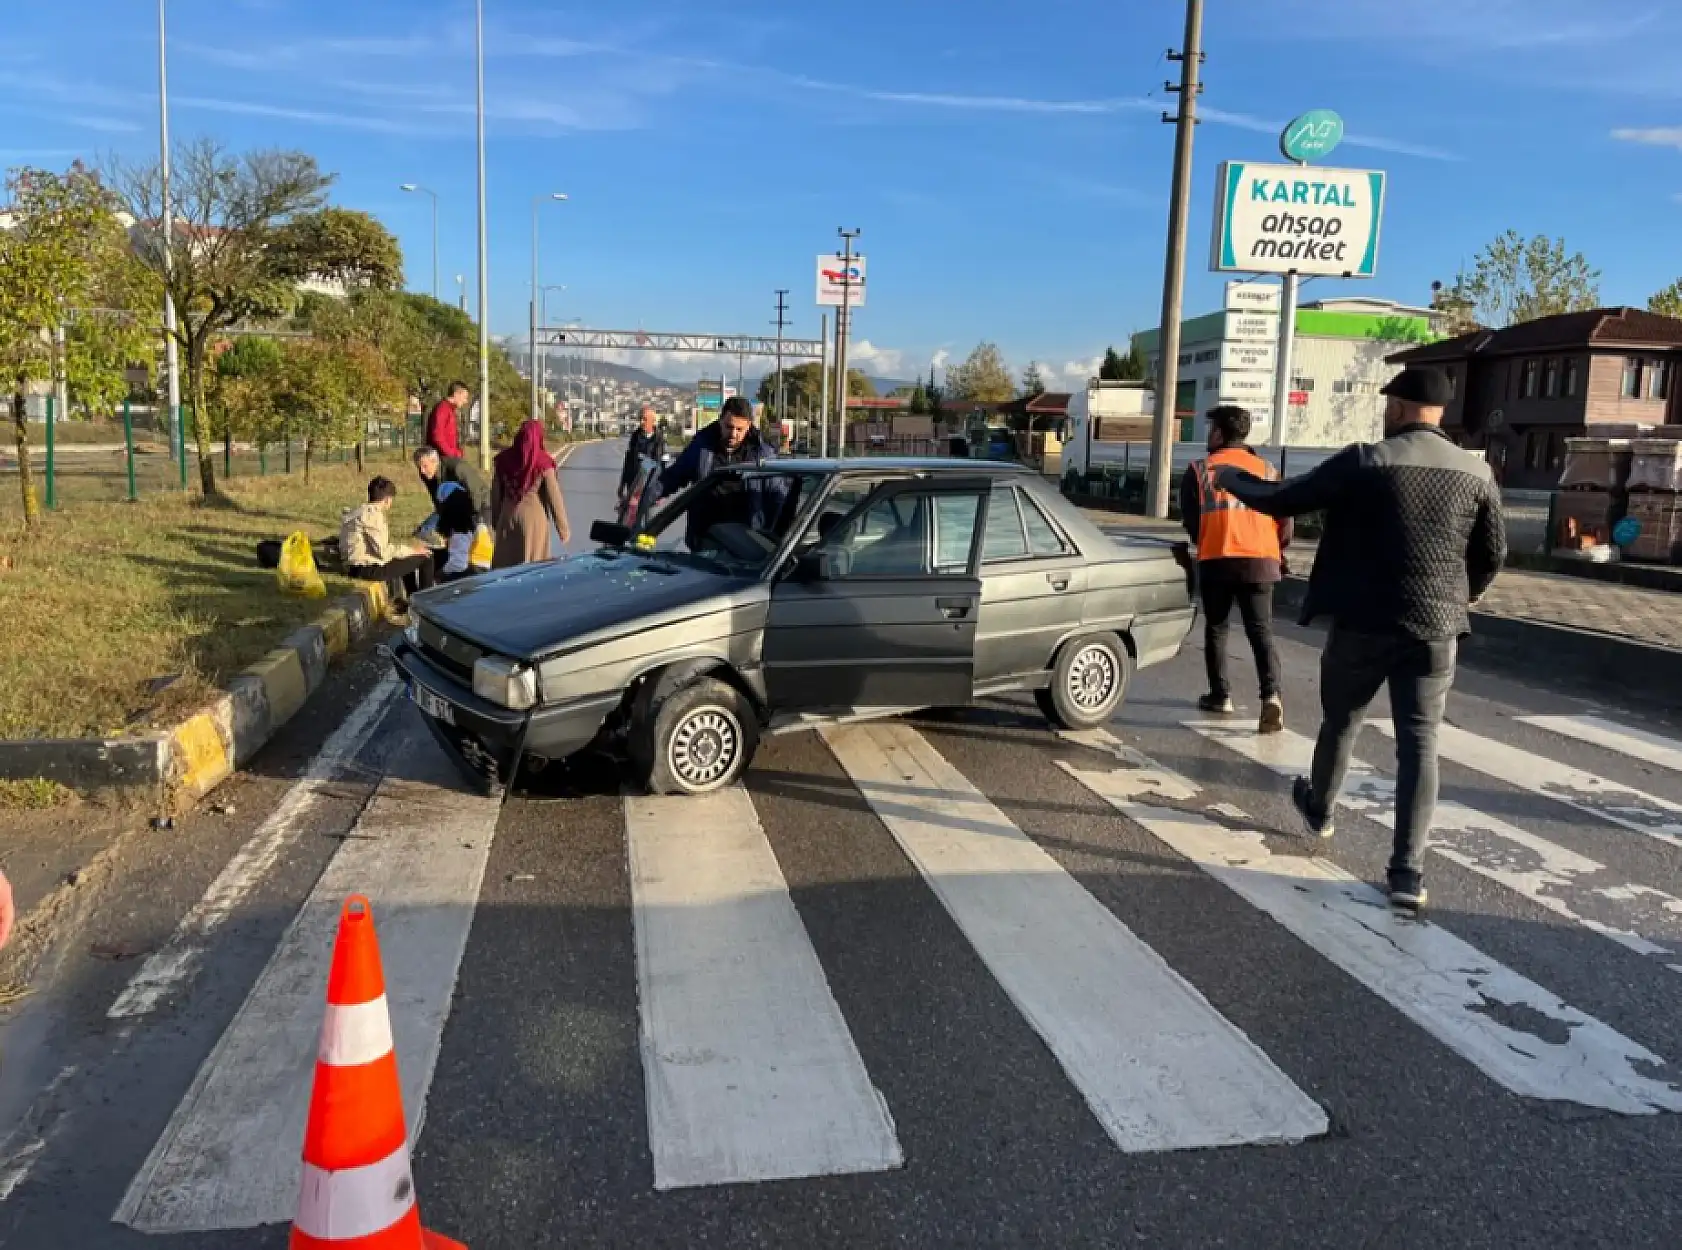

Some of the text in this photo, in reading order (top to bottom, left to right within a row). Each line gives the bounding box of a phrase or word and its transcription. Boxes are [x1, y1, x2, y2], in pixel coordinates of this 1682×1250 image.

[1251, 179, 1356, 207] KARTAL
[1261, 211, 1342, 238] ahşap
[1251, 238, 1347, 261] market
